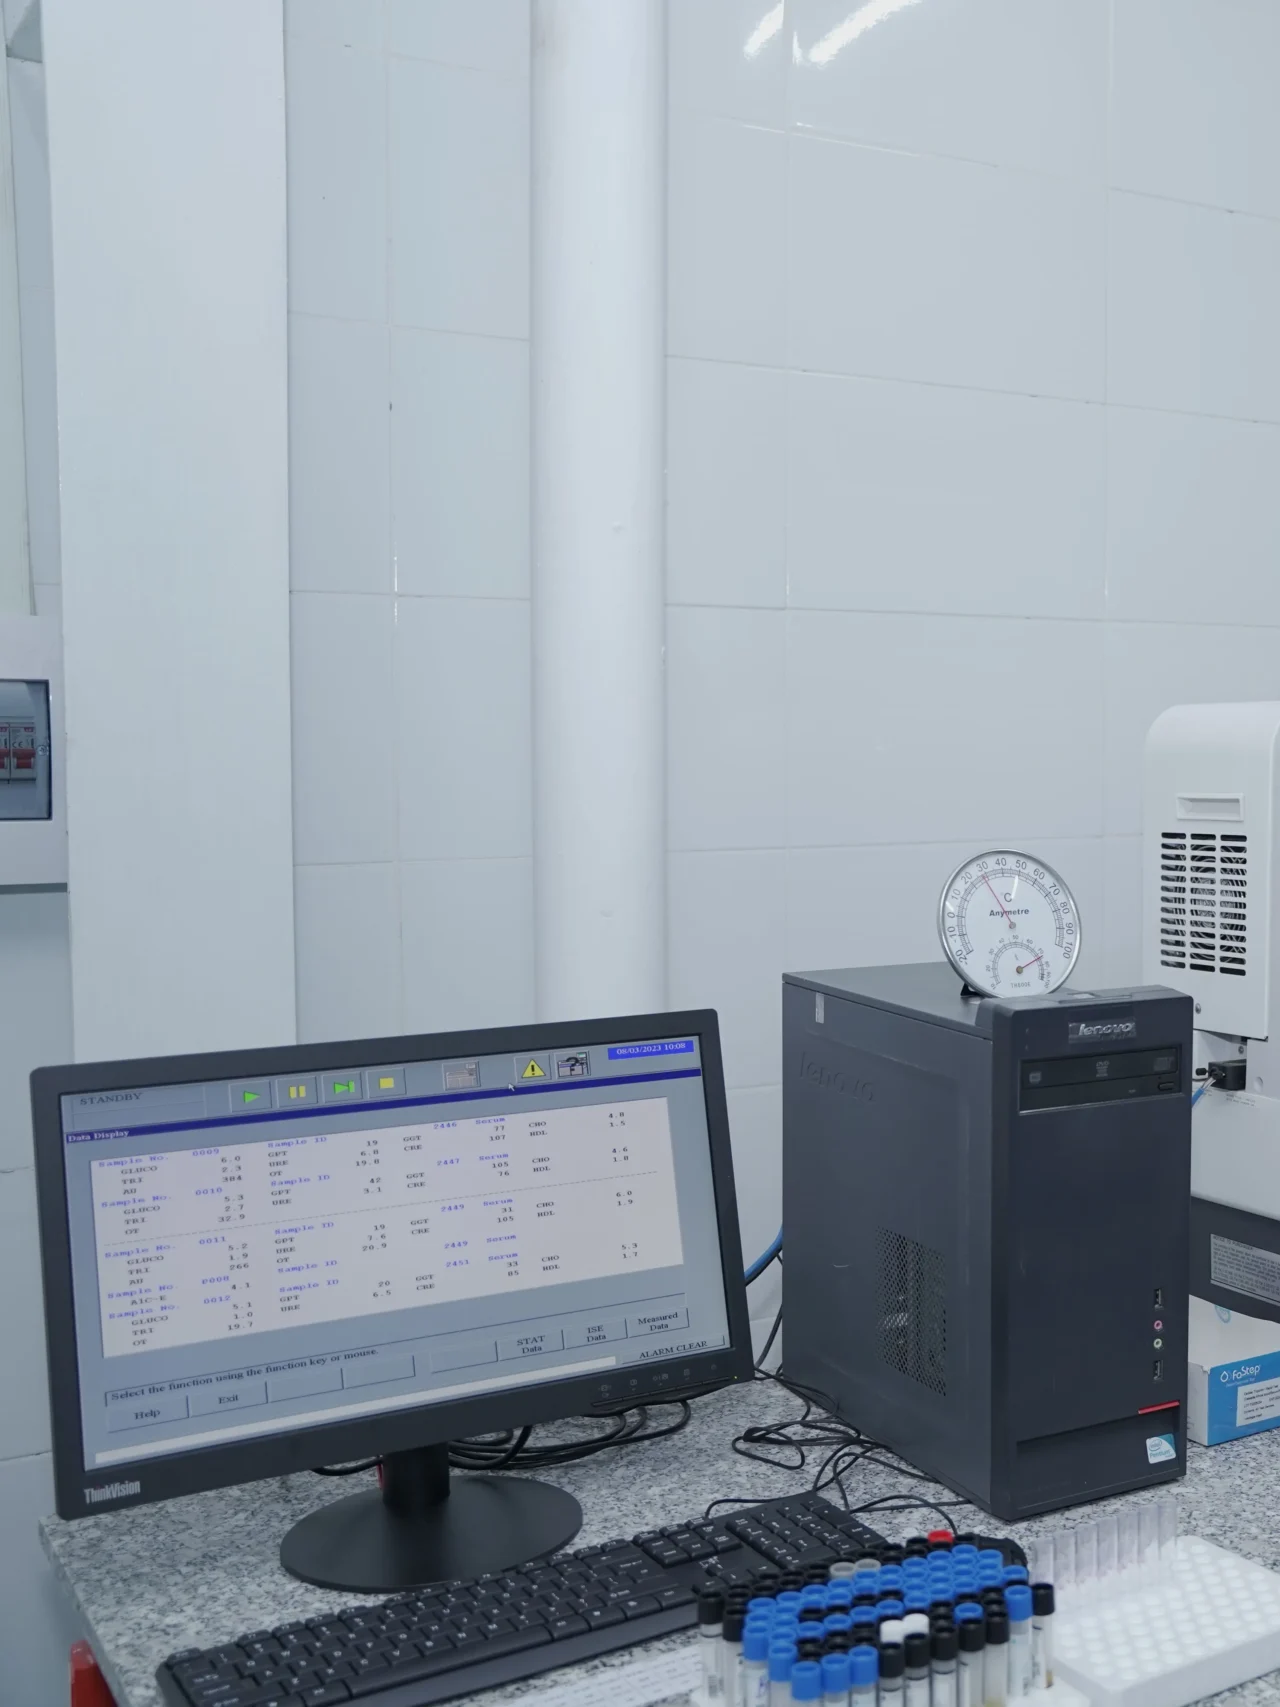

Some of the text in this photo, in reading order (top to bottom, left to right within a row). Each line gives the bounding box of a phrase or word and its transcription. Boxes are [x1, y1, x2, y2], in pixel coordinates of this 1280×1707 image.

[976, 861, 989, 872] 30
[995, 857, 1007, 867] 40
[1015, 859, 1027, 870] 50
[961, 871, 973, 884] 20
[1033, 868, 1045, 880] 60
[951, 888, 961, 901] 10
[1048, 882, 1061, 896] 70
[989, 908, 1030, 918] Anymetre
[1060, 901, 1070, 914] 80
[946, 911, 956, 919] 0
[946, 926, 957, 943] -10
[1065, 922, 1074, 935] 90
[1062, 941, 1073, 959] 100
[955, 949, 968, 965] -20
[1078, 1022, 1134, 1036] lenovo
[616, 1042, 686, 1056] 08/03/2023 10:08
[80, 1092, 143, 1106] STANDBY
[68, 1129, 130, 1142] Data Display
[98, 1157, 143, 1168] Sample
[192, 1147, 220, 1157] 0009
[268, 1139, 308, 1148] Sample
[434, 1121, 458, 1129] 2446
[121, 1165, 159, 1174] GLUCO
[221, 1155, 242, 1163] 6.0
[222, 1164, 243, 1173] 2.3
[102, 1197, 146, 1208] Sample
[196, 1186, 224, 1196] 0010
[271, 1177, 312, 1187] Sample
[437, 1157, 460, 1166] 2447
[124, 1205, 162, 1215] GLUCO
[224, 1193, 245, 1202] 5.3
[406, 1171, 425, 1179] GGT
[225, 1203, 245, 1212] 2.7
[218, 1213, 246, 1223] 32.9
[105, 1247, 150, 1258] Sample
[199, 1235, 227, 1245] 0011
[275, 1224, 315, 1235] Sample
[442, 1203, 465, 1212] 2449
[230, 1252, 249, 1261] 1.9
[498, 1215, 515, 1223] 105
[618, 1198, 634, 1206] 1.9
[127, 1254, 165, 1265] GLUCO
[228, 1242, 249, 1251] 5.2
[374, 1223, 386, 1231] 19
[410, 1218, 430, 1226] GGT
[230, 1262, 250, 1271] 266
[132, 1315, 169, 1326] GLUCO
[233, 1301, 253, 1310] 5.1
[378, 1279, 392, 1288] 20
[416, 1273, 435, 1281] GGT
[622, 1242, 639, 1250] 5.3
[232, 1281, 251, 1290] 4.1
[234, 1311, 254, 1320] 1.0
[373, 1289, 392, 1298] 6.5
[623, 1251, 639, 1259] 1.7
[109, 1307, 154, 1319] Sample
[204, 1295, 231, 1304] 0012
[280, 1282, 320, 1293] Sample
[327, 1278, 340, 1286] ID
[638, 1312, 679, 1325] Measured
[228, 1321, 254, 1331] 19.7
[587, 1324, 604, 1334] ISE
[649, 1323, 669, 1332] Data
[517, 1335, 546, 1346] STAT
[586, 1333, 607, 1343] Data
[521, 1344, 542, 1354] Data
[639, 1340, 708, 1360] ALARM CLEAR
[111, 1348, 379, 1402] Select the function using the function key or mouse.
[218, 1394, 239, 1405] Exit
[134, 1409, 161, 1421] Help
[84, 1480, 141, 1505] ThinkVision
